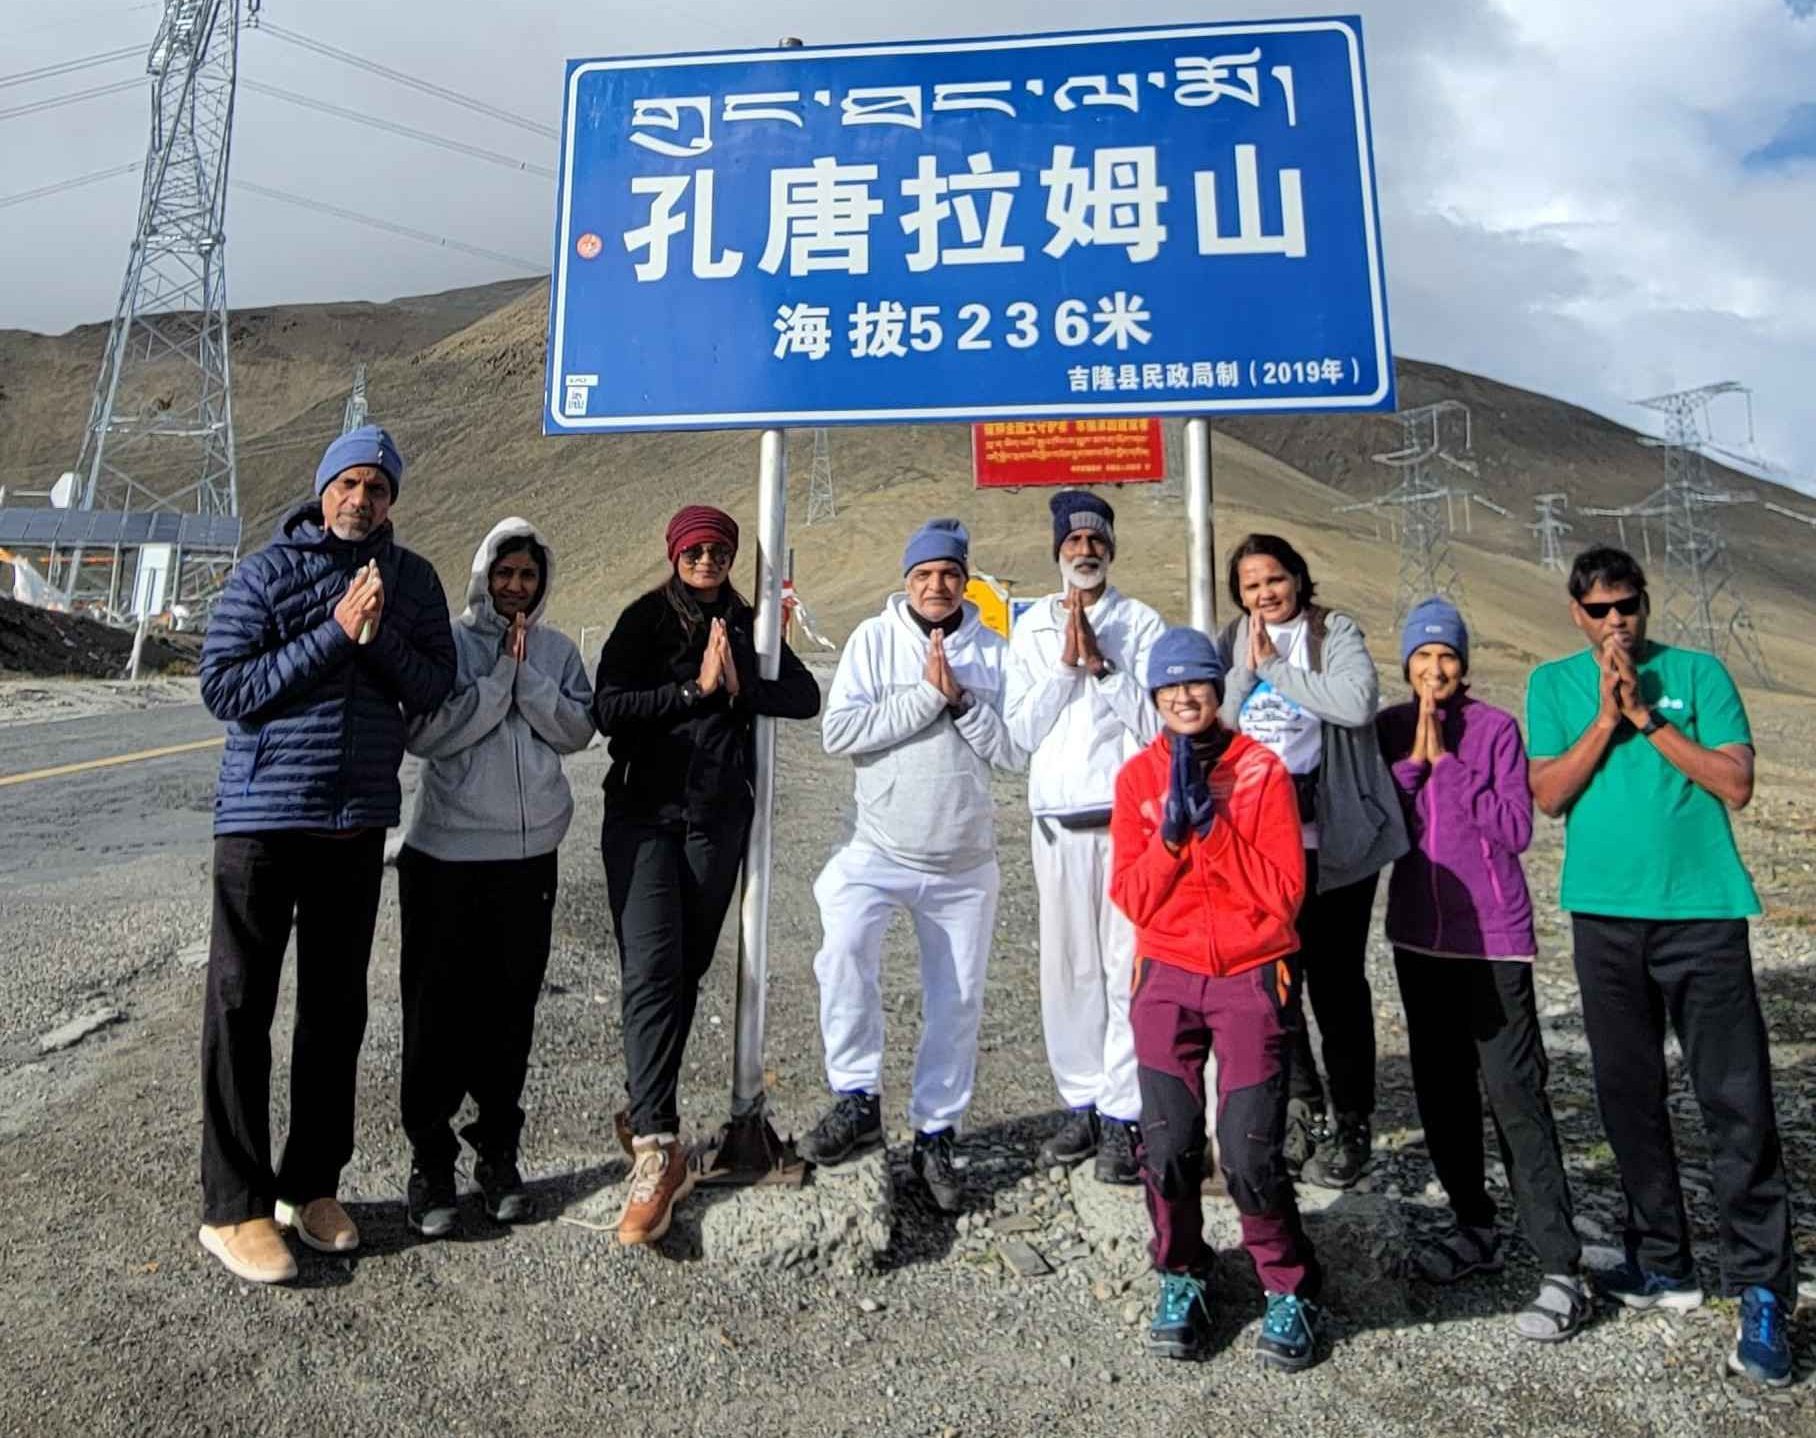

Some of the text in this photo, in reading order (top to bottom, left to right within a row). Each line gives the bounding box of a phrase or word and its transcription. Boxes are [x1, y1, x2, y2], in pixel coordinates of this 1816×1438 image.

[623, 144, 1306, 282] 孔唐拉姆山
[773, 291, 1151, 360] 海拔5236米
